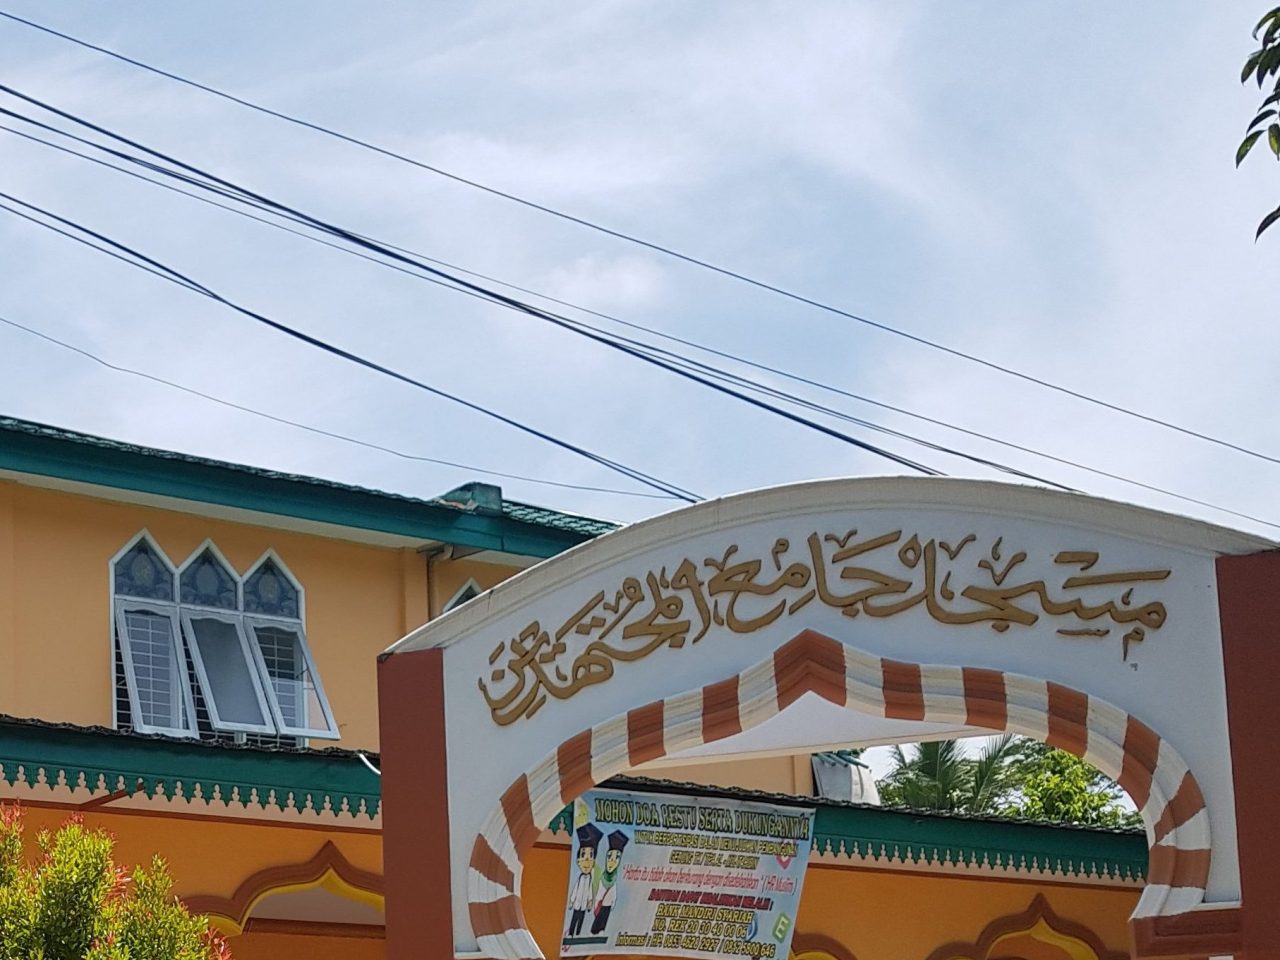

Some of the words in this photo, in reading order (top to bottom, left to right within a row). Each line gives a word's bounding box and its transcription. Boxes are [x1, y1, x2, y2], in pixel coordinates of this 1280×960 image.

[596, 800, 634, 823] MOHON
[634, 803, 660, 826] DOA
[660, 804, 698, 830] RESTU
[698, 807, 733, 834] SERTA
[656, 903, 681, 917] BANK
[679, 905, 717, 921] MANDIRI
[715, 908, 754, 924] SYARIAH
[667, 919, 688, 933] REK
[686, 920, 699, 934] 20
[699, 921, 712, 935] 30
[711, 921, 724, 936] 40
[723, 923, 736, 938] 00
